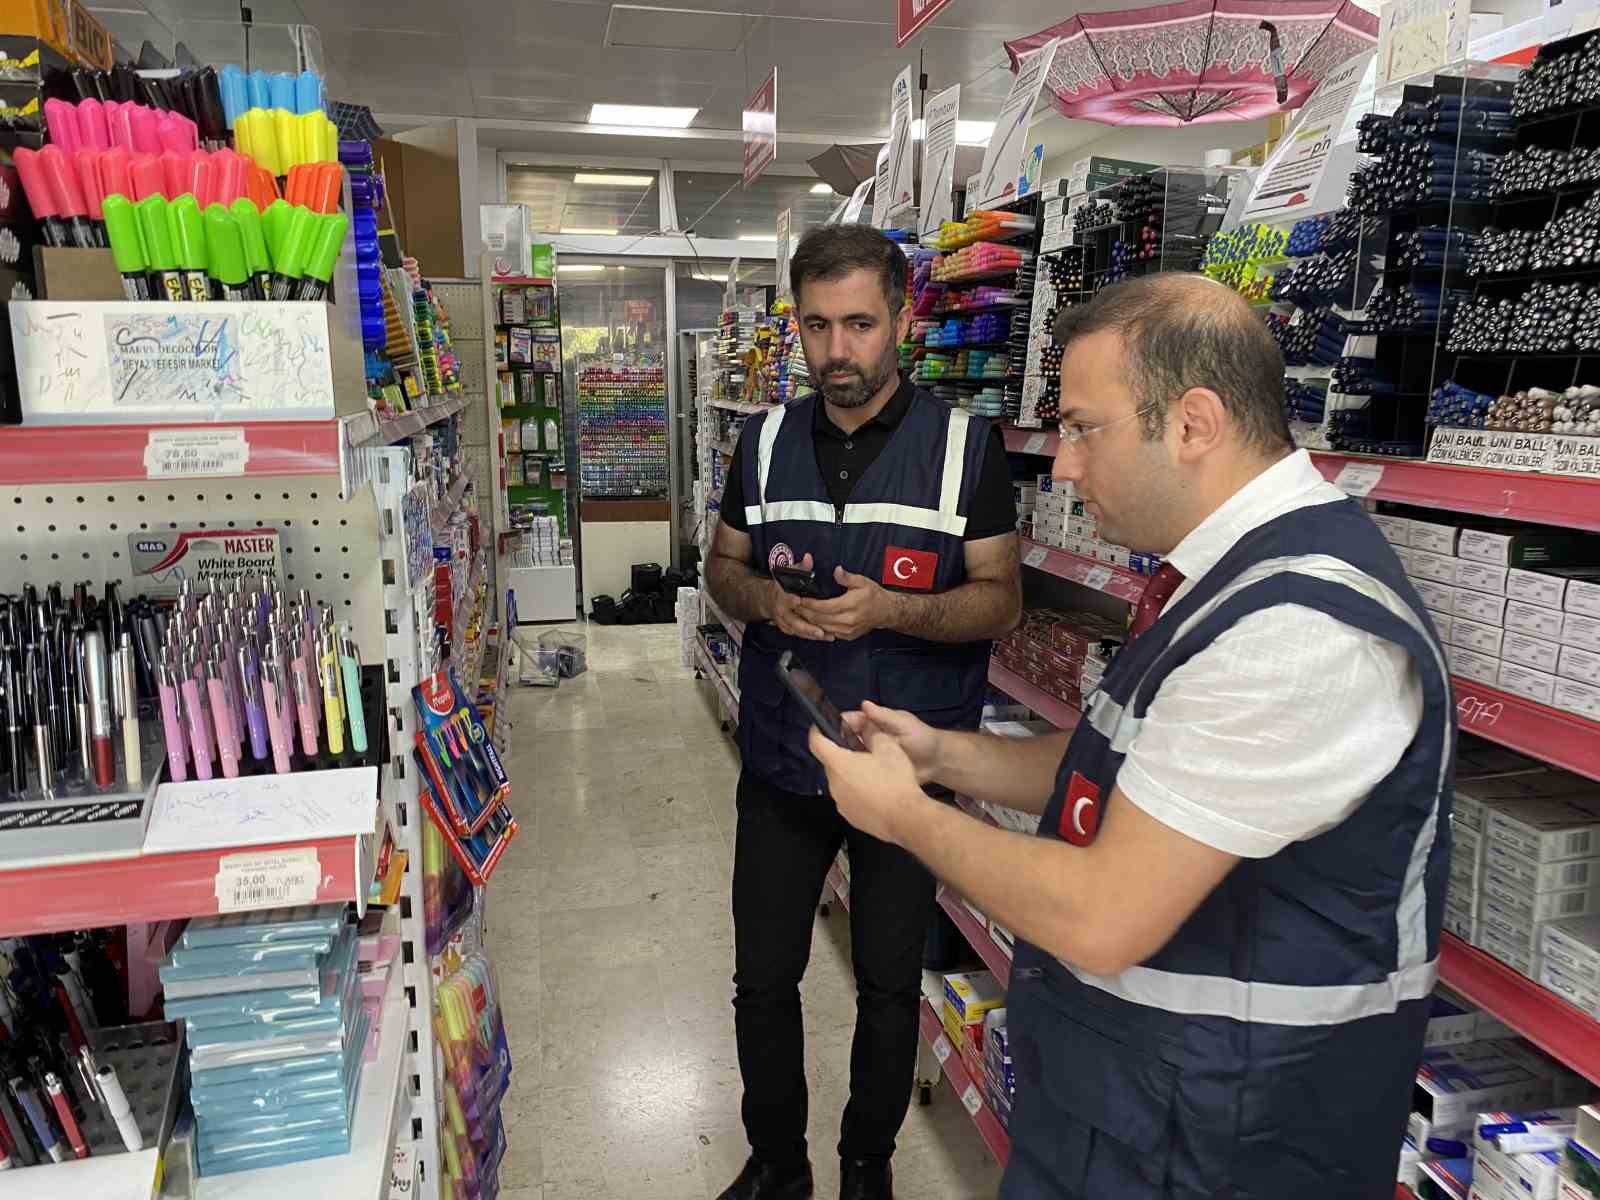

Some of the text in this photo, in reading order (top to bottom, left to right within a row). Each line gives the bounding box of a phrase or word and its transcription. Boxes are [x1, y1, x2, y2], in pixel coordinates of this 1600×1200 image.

[75, 17, 106, 62] BIC
[1434, 433, 1454, 445] UNI
[1490, 437, 1546, 452] UNI BALL
[138, 542, 164, 551] MAS
[224, 539, 274, 554] MASTER
[198, 555, 275, 570] White Board
[197, 569, 242, 581] Marker
